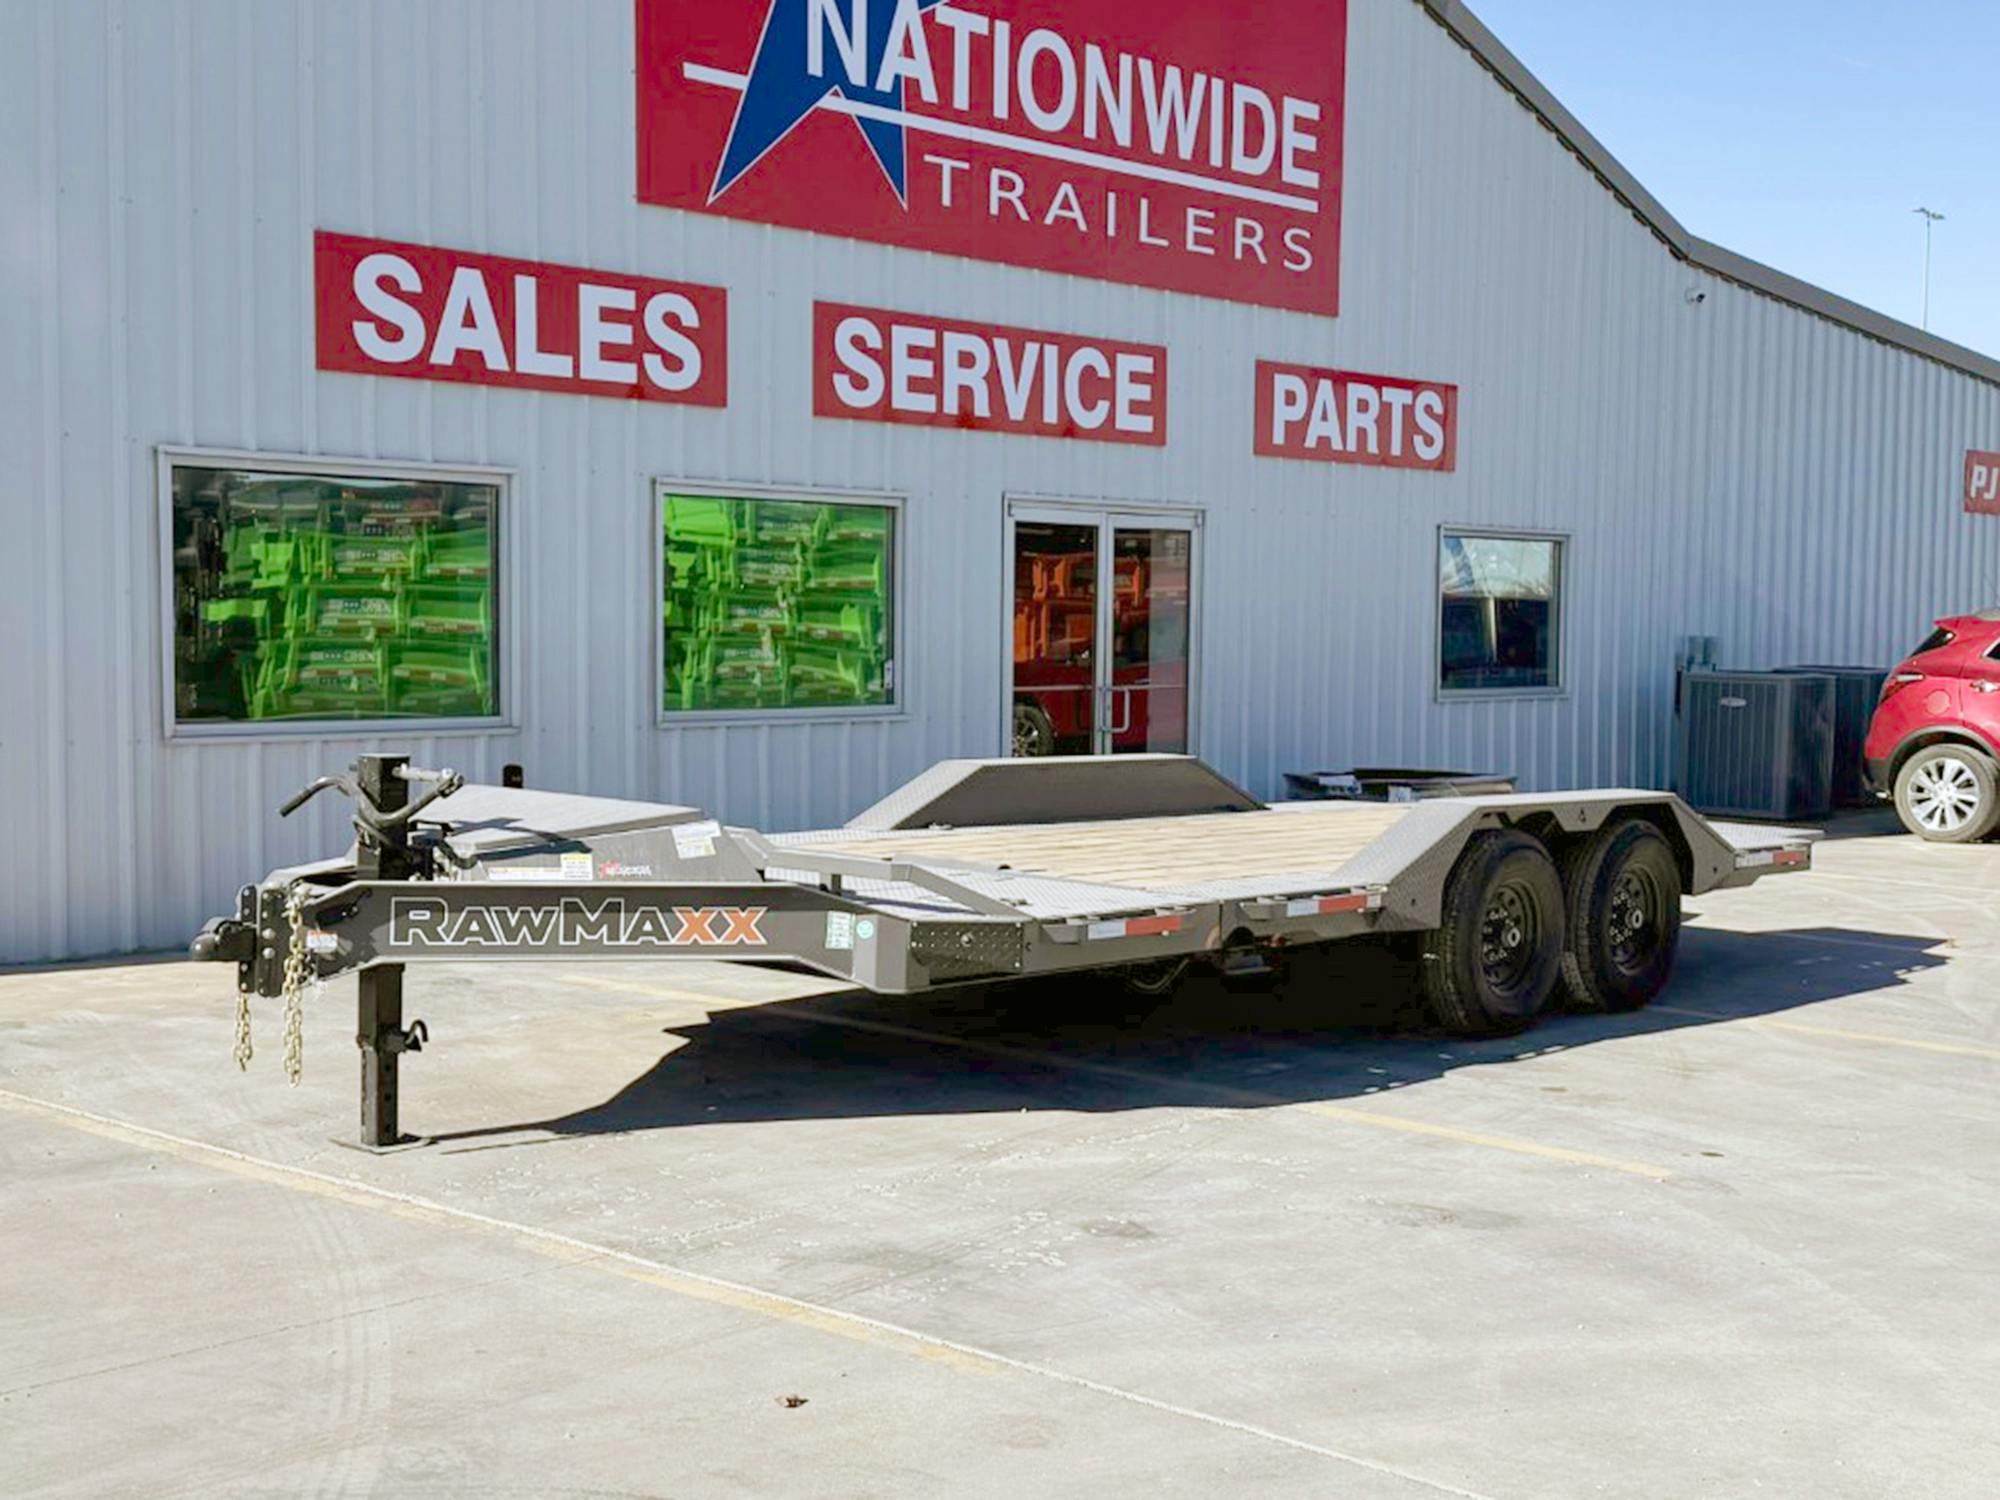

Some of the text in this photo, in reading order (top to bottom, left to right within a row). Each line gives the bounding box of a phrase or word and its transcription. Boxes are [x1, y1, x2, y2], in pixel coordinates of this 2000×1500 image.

[807, 0, 1320, 189] NATIONWIDE
[923, 154, 1314, 272] TRAILERS
[352, 253, 702, 391] SALES
[832, 316, 1155, 433] SERVICE
[1272, 372, 1444, 461] PARTS
[1970, 464, 1999, 500] PJ
